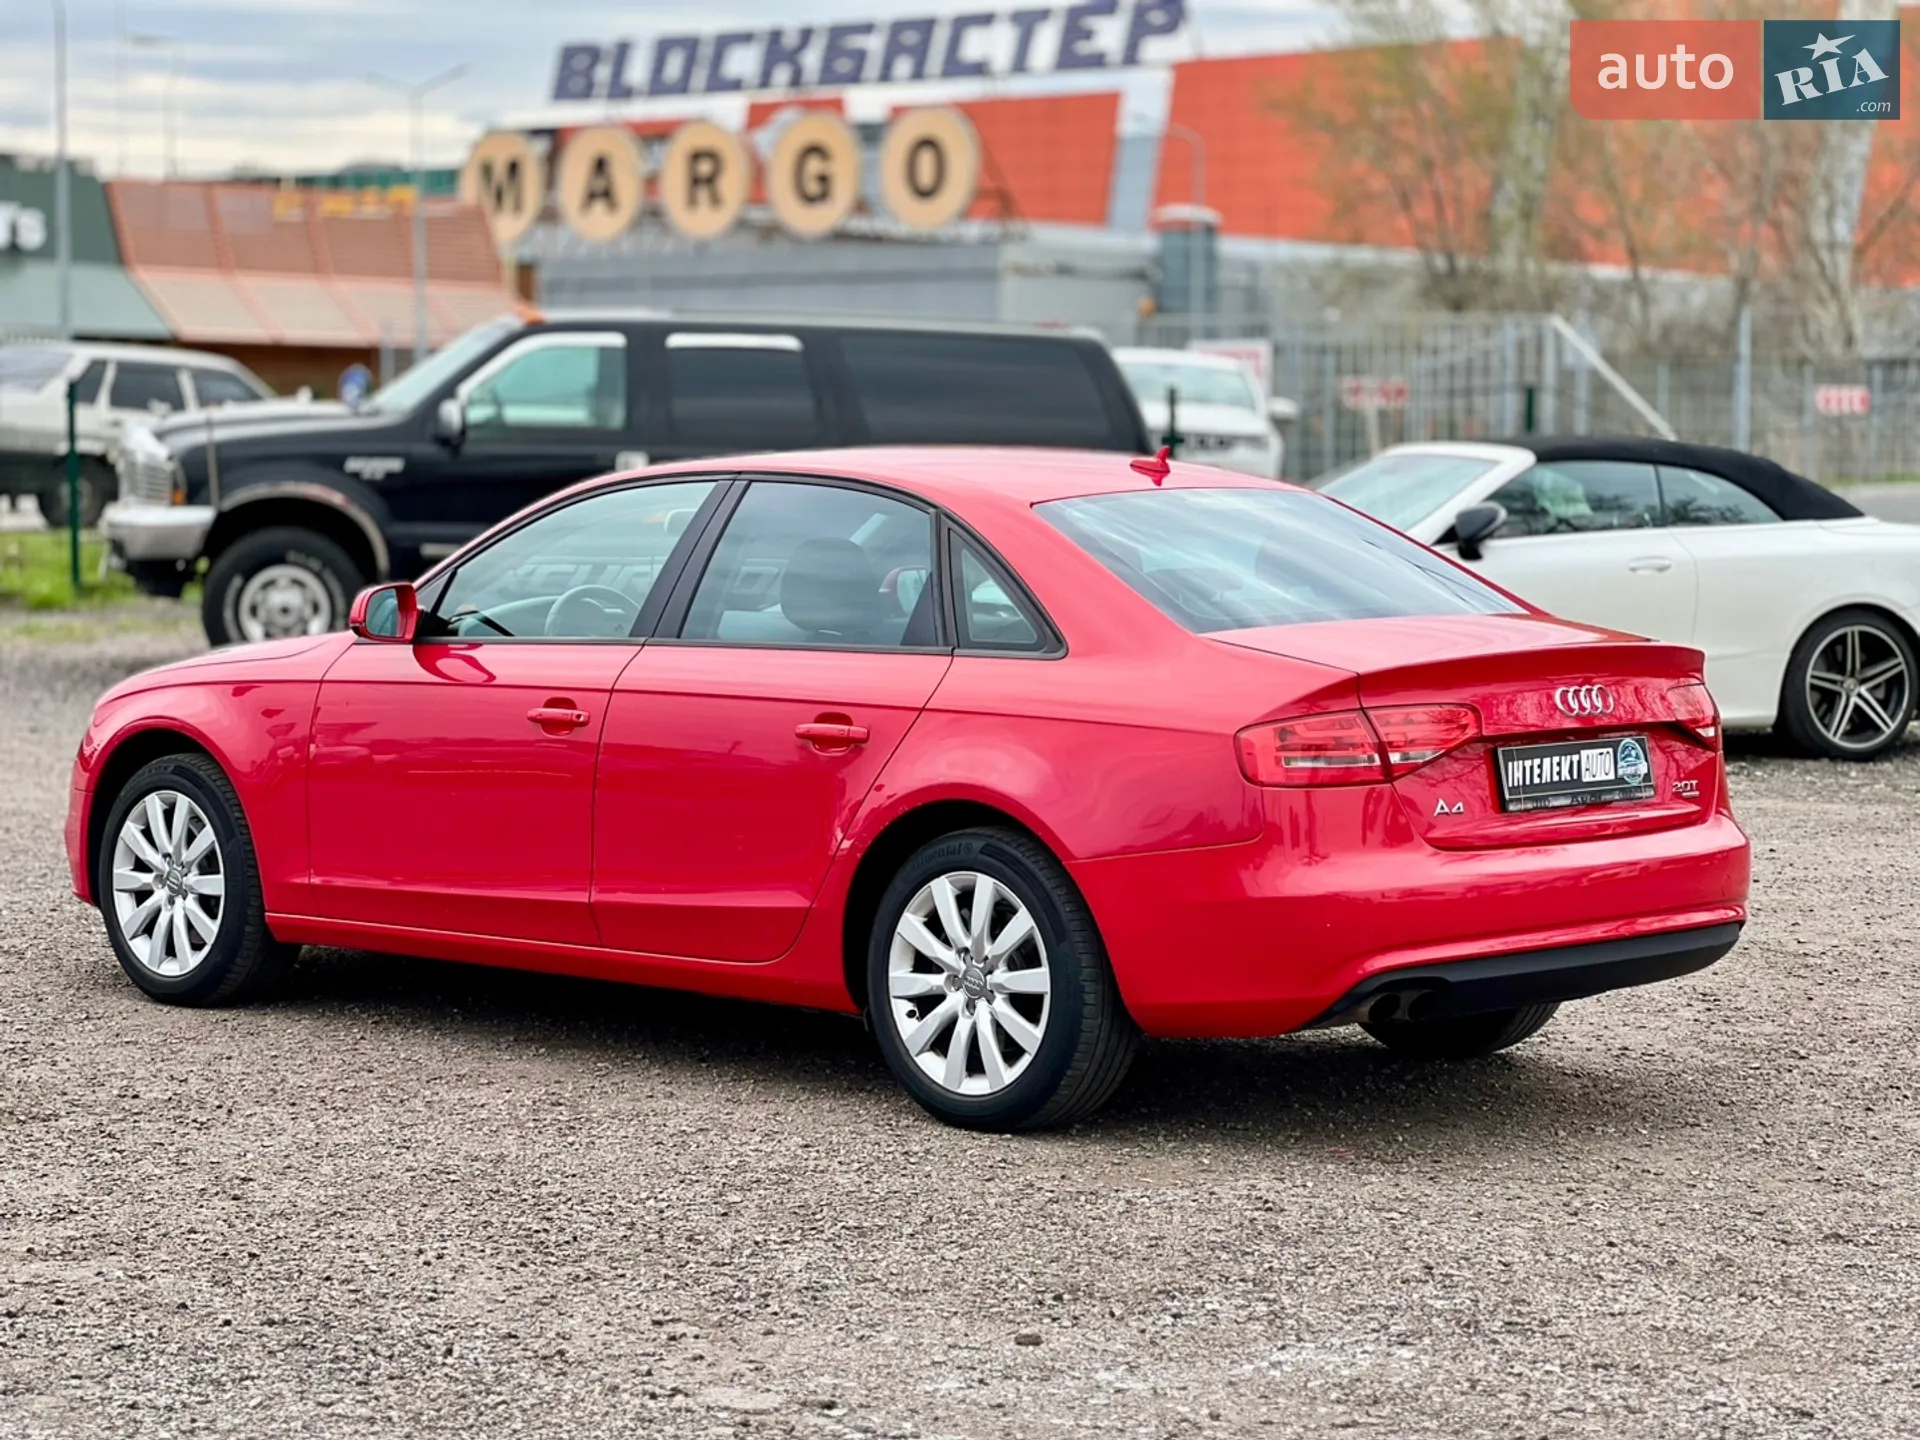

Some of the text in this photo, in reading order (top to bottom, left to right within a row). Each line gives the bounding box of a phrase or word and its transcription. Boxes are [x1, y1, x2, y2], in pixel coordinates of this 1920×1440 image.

[476, 137, 948, 217] MARGO
[1583, 750, 1612, 780] AUTO
[1433, 797, 1465, 818] A4
